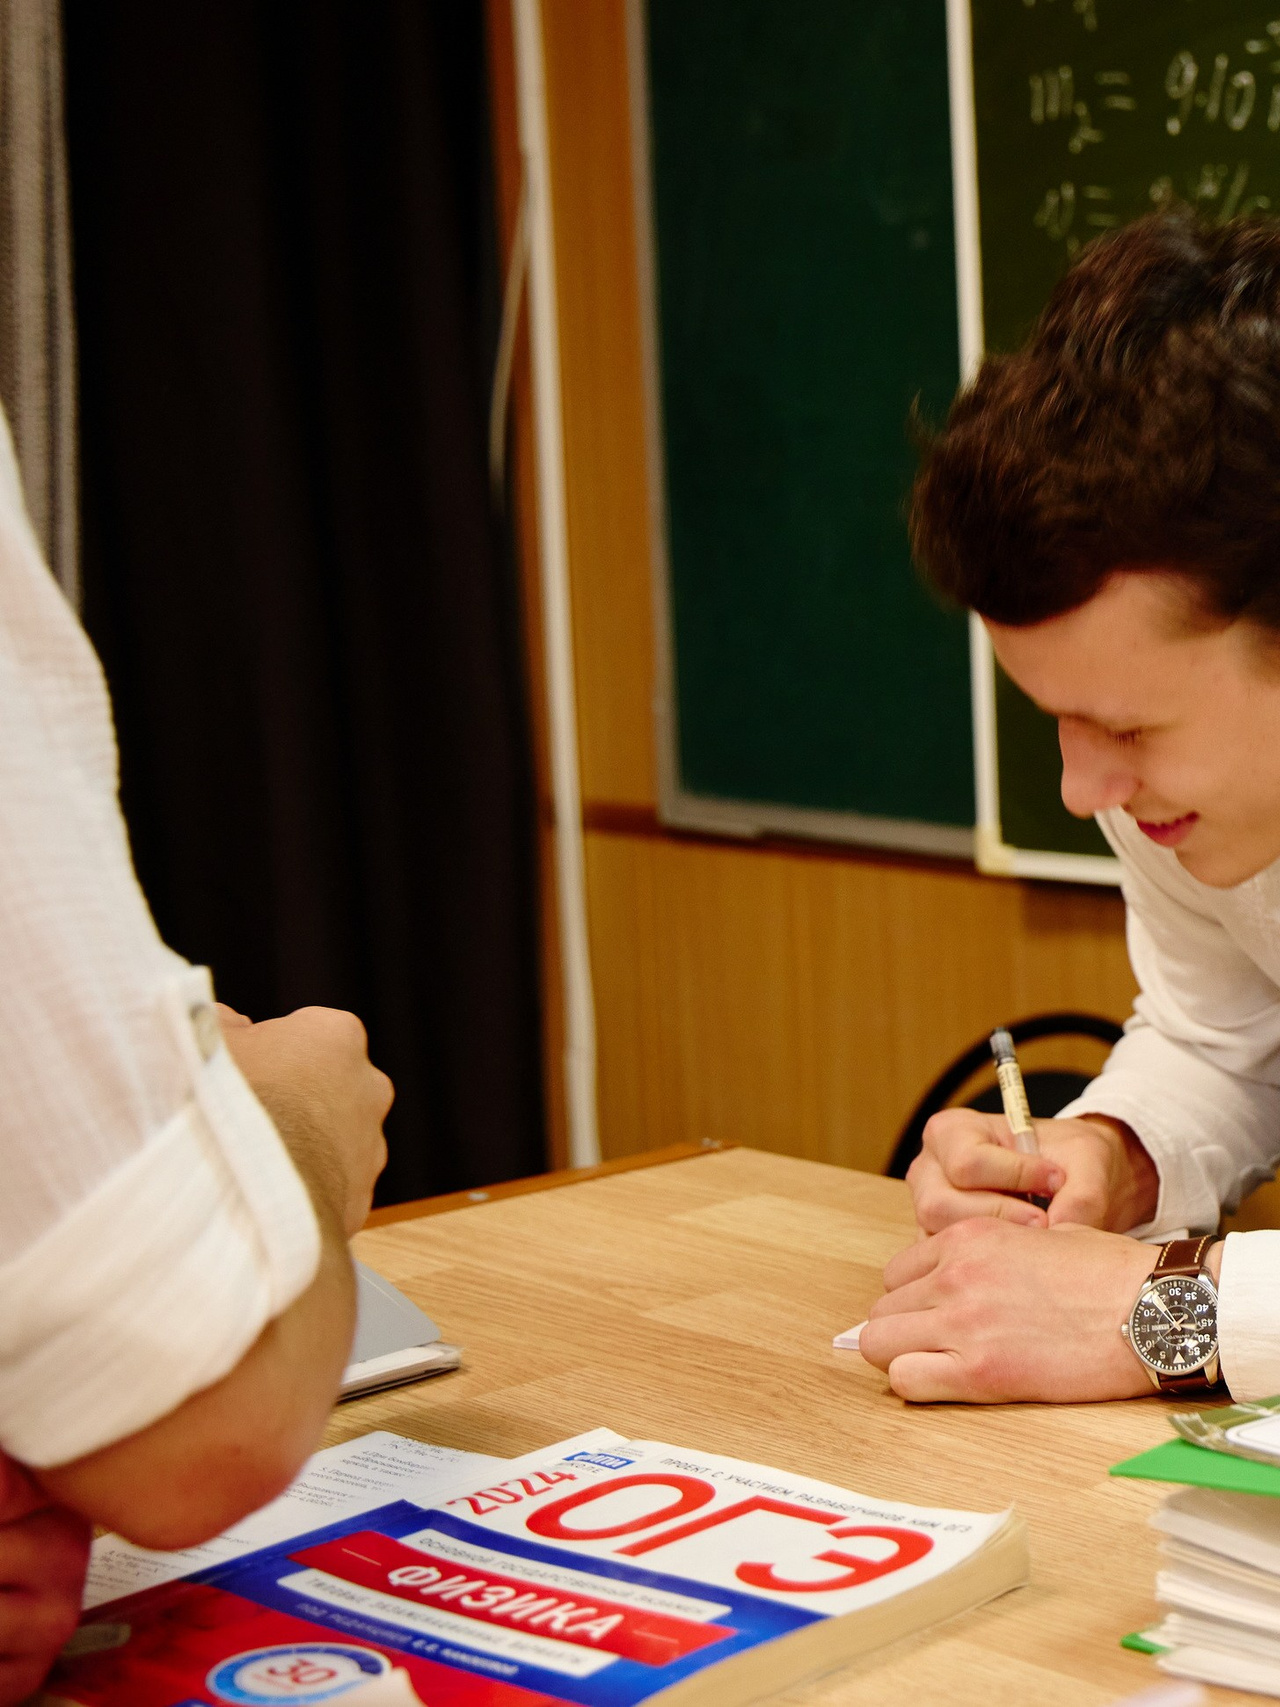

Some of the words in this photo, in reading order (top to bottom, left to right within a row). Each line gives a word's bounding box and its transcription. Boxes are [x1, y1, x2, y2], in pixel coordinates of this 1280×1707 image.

[1169, 1287, 1182, 1296] 30
[1185, 1292, 1197, 1300] 35
[1143, 1308, 1156, 1317] 20
[1196, 1304, 1209, 1312] 40
[1198, 1334, 1210, 1343] 50
[660, 1458, 711, 1474] ПРОЕКТ
[725, 1474, 793, 1496] УЧАСТИЕМ
[446, 1472, 579, 1515] 2024
[524, 1472, 936, 1593] ОГЭ
[387, 1565, 626, 1639] ФИЗИКА
